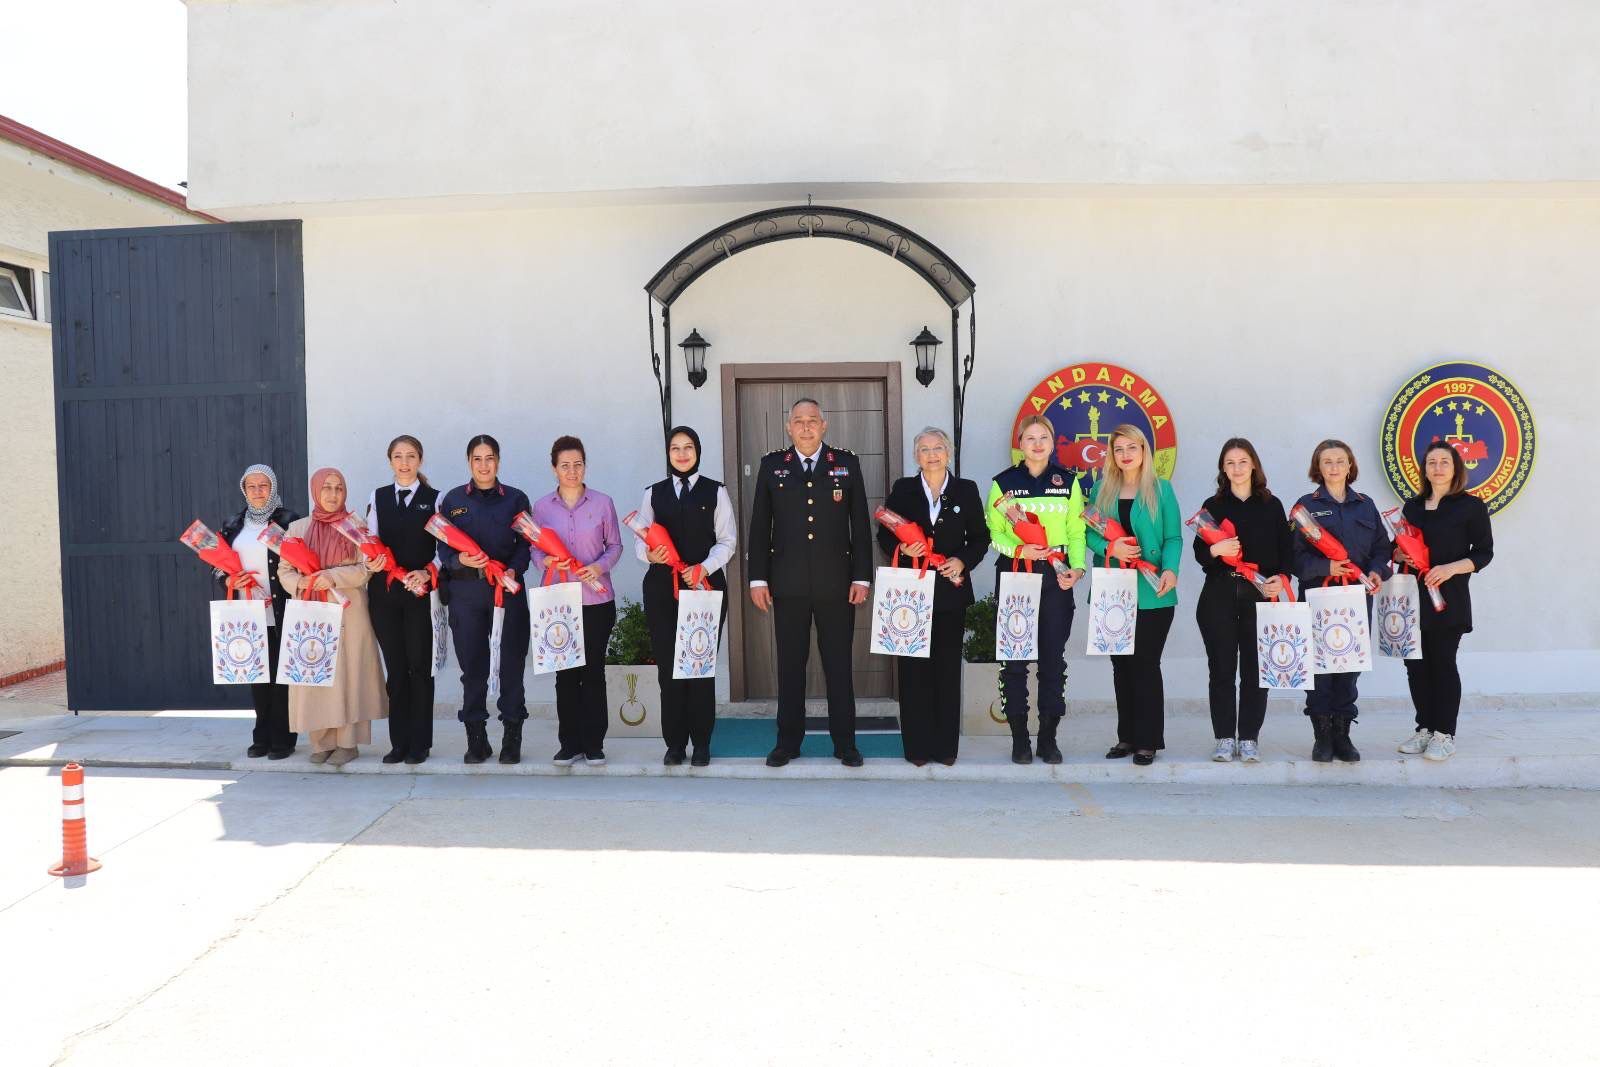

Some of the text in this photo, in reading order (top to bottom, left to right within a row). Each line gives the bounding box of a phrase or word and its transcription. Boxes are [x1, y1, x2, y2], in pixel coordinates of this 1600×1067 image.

[1030, 367, 1168, 429] ANDARMA
[1443, 383, 1475, 394] 1997
[1402, 455, 1422, 488] JAND
